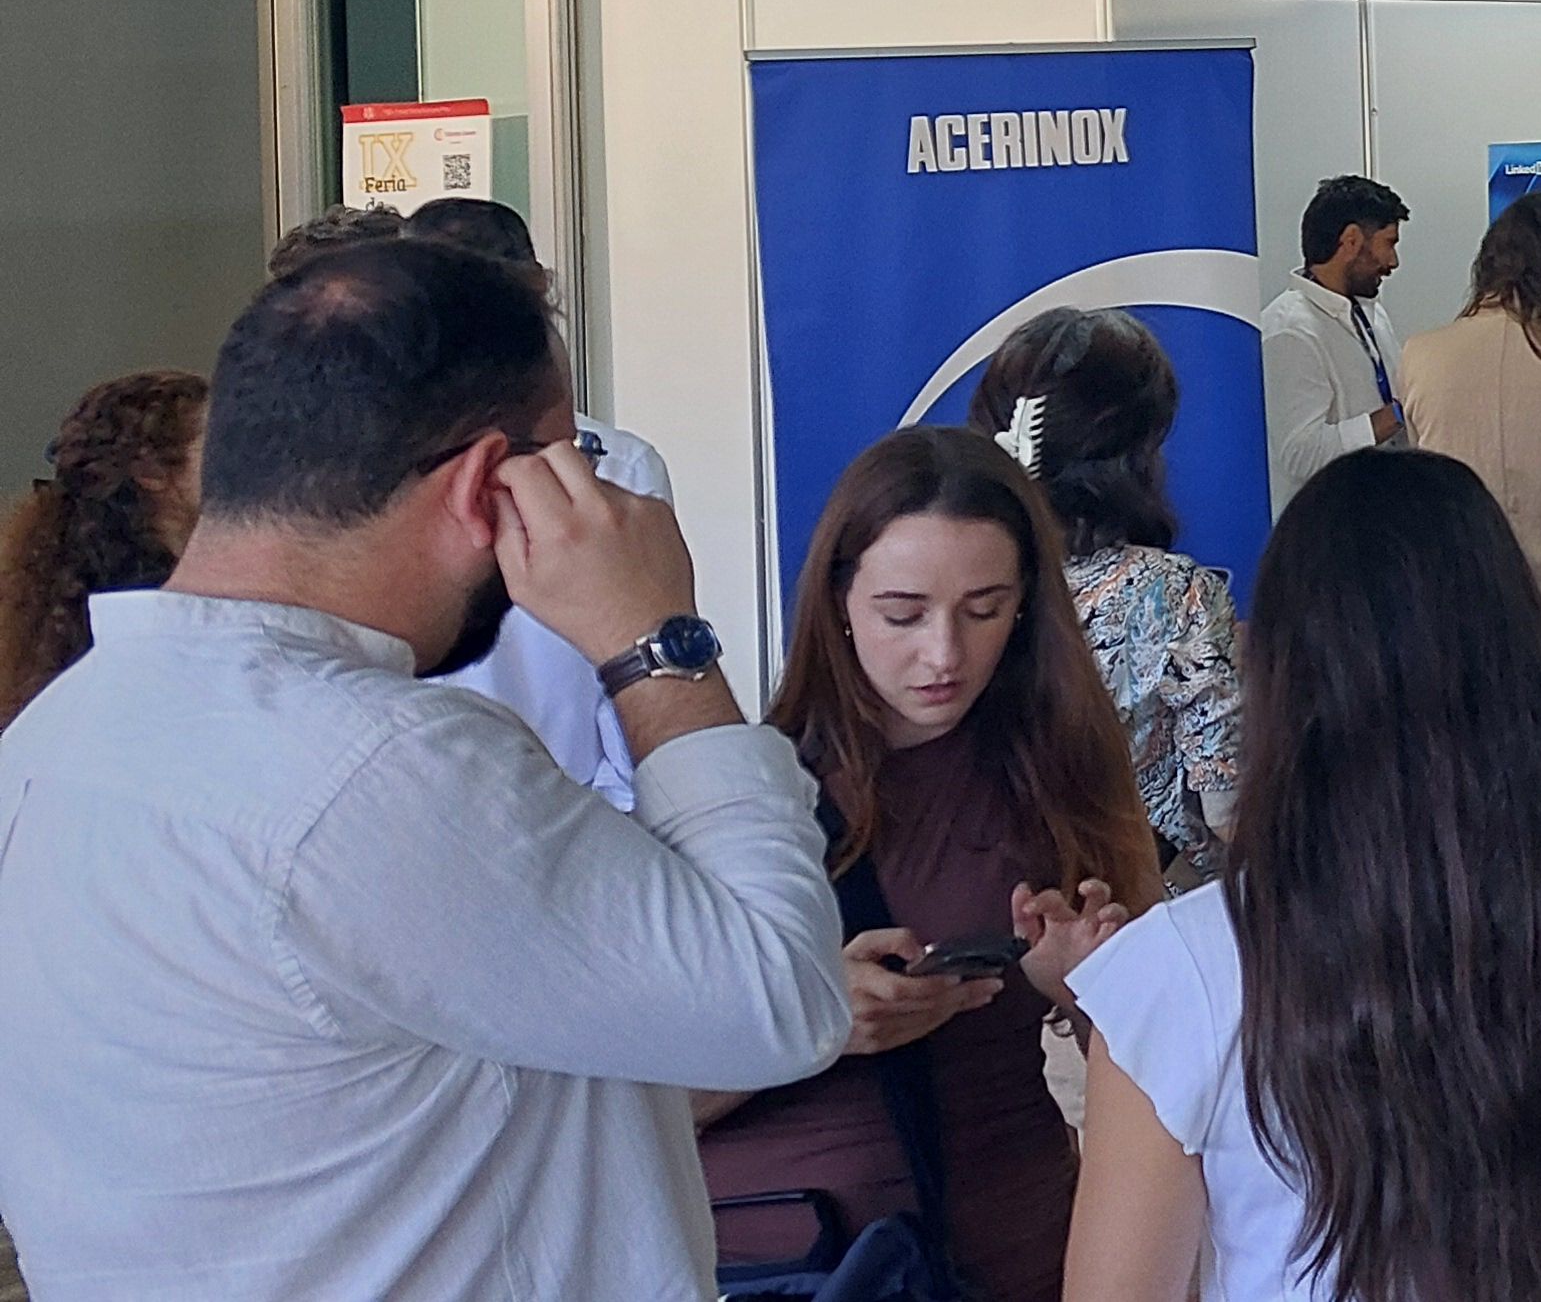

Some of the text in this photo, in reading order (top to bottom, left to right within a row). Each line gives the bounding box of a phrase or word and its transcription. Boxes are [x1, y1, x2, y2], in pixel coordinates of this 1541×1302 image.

[359, 132, 417, 189] IX
[907, 108, 1129, 174] ACERINOX
[364, 175, 407, 193] Feria
